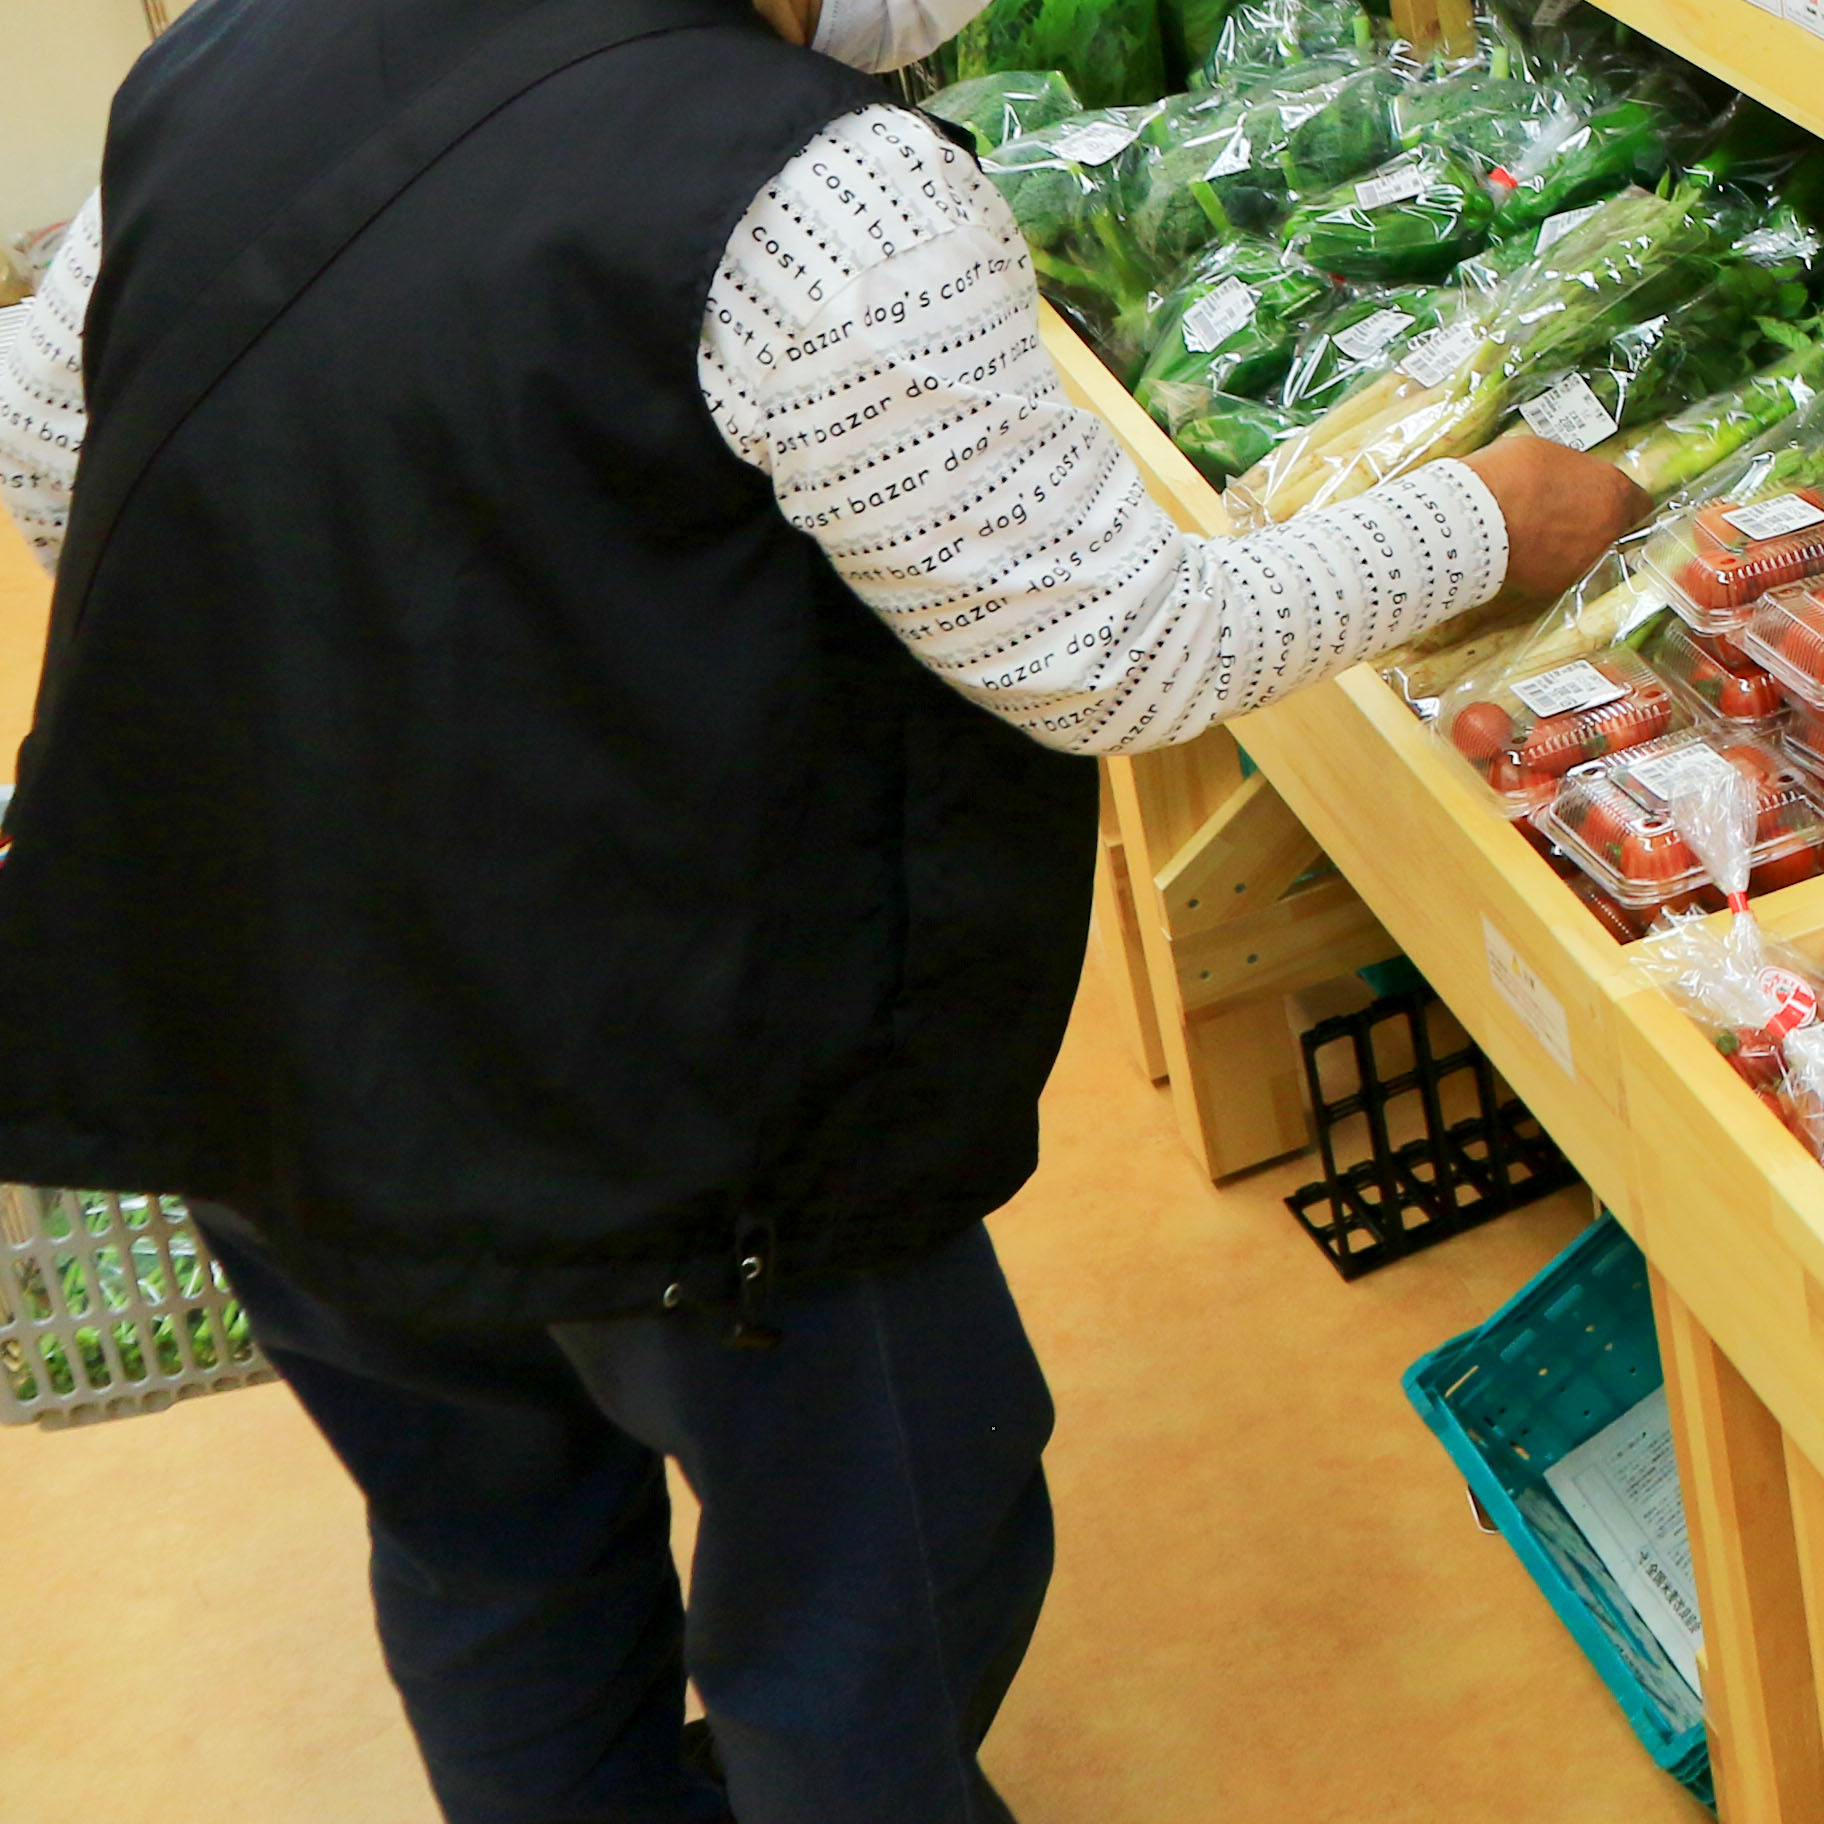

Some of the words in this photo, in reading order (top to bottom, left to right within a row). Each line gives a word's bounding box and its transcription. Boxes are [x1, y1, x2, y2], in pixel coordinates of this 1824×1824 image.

[871, 122, 925, 173] cost
[811, 162, 868, 217] cost
[751, 226, 808, 281] cost
[786, 318, 855, 364] bazar
[863, 290, 931, 327] dog's
[940, 260, 983, 301] cost
[813, 395, 893, 444] bazar
[847, 469, 931, 515] bazar
[944, 420, 1011, 473] dog's
[886, 535, 967, 581] bazar
[978, 486, 1048, 539] dog's
[1049, 446, 1082, 488] cost
[1088, 516, 1126, 555] cost
[1352, 511, 1396, 560] cost
[1414, 492, 1453, 540] cost
[982, 651, 1056, 692] bazar
